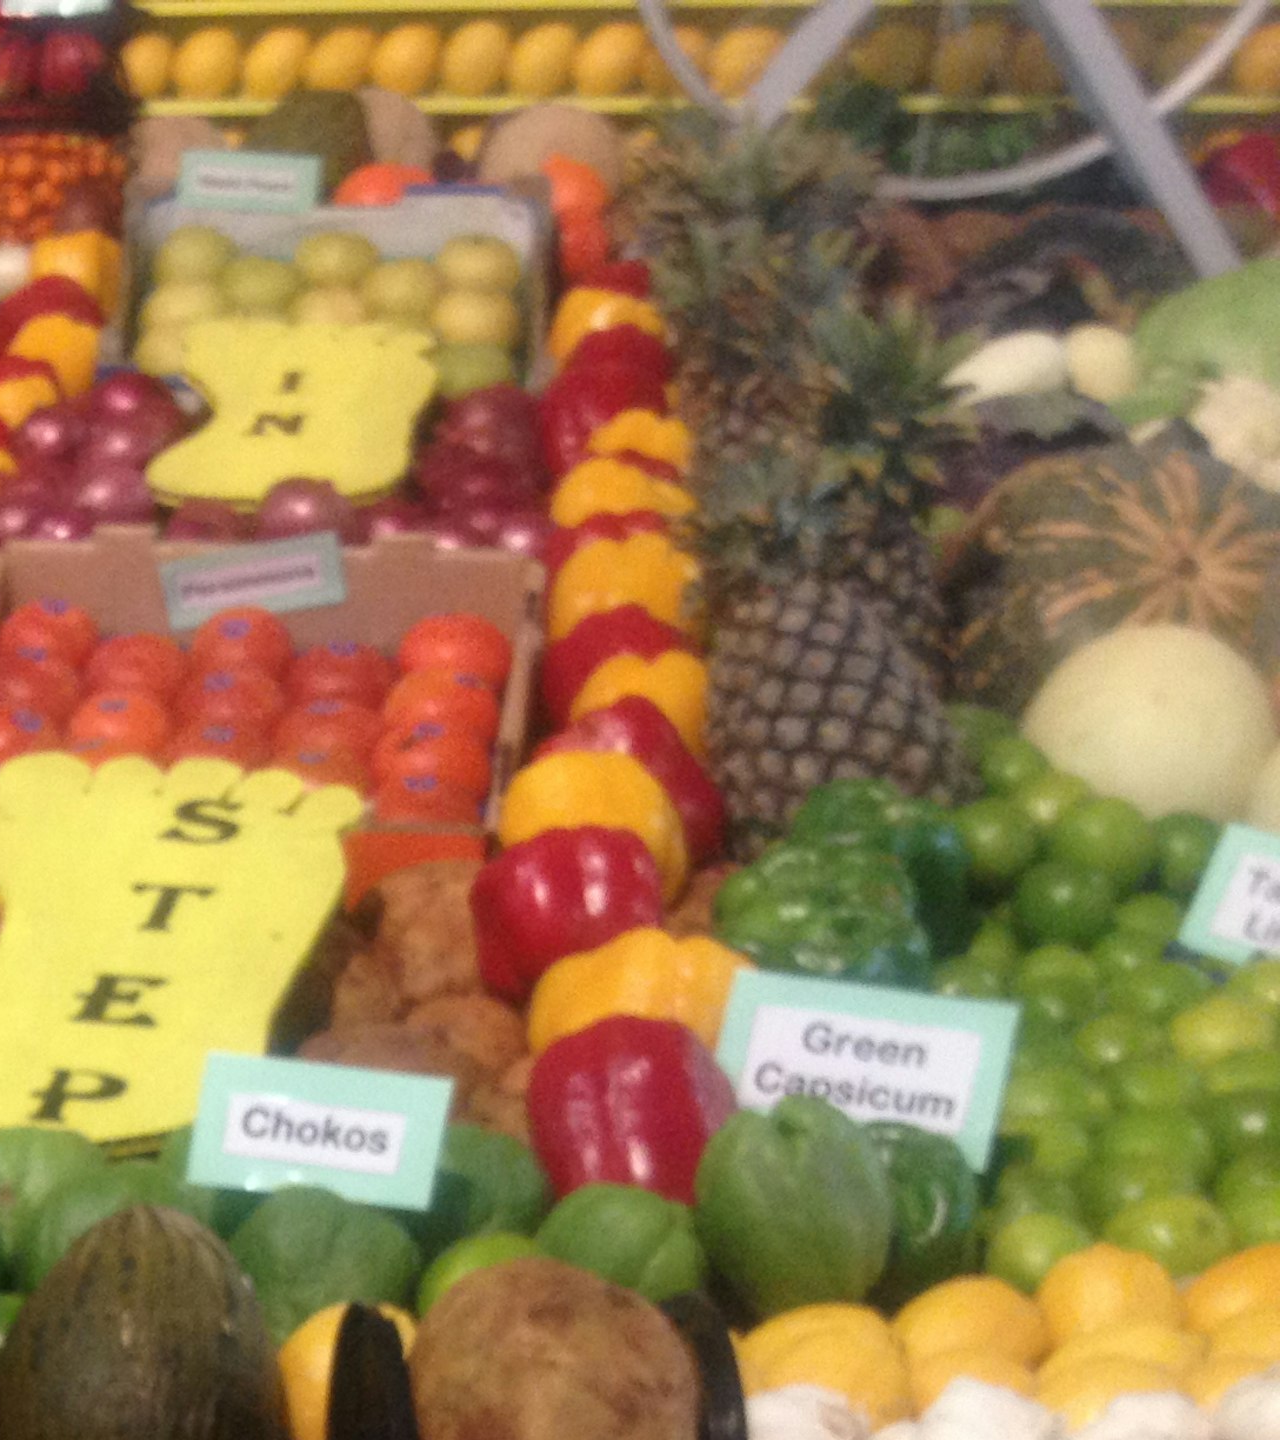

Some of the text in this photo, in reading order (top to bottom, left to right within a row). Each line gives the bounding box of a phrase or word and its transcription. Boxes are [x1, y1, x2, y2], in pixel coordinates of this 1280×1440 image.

[28, 797, 243, 1122] STEP
[801, 1020, 928, 1069] Green
[753, 1061, 958, 1121] Capsicum
[242, 1104, 390, 1155] Chokos
